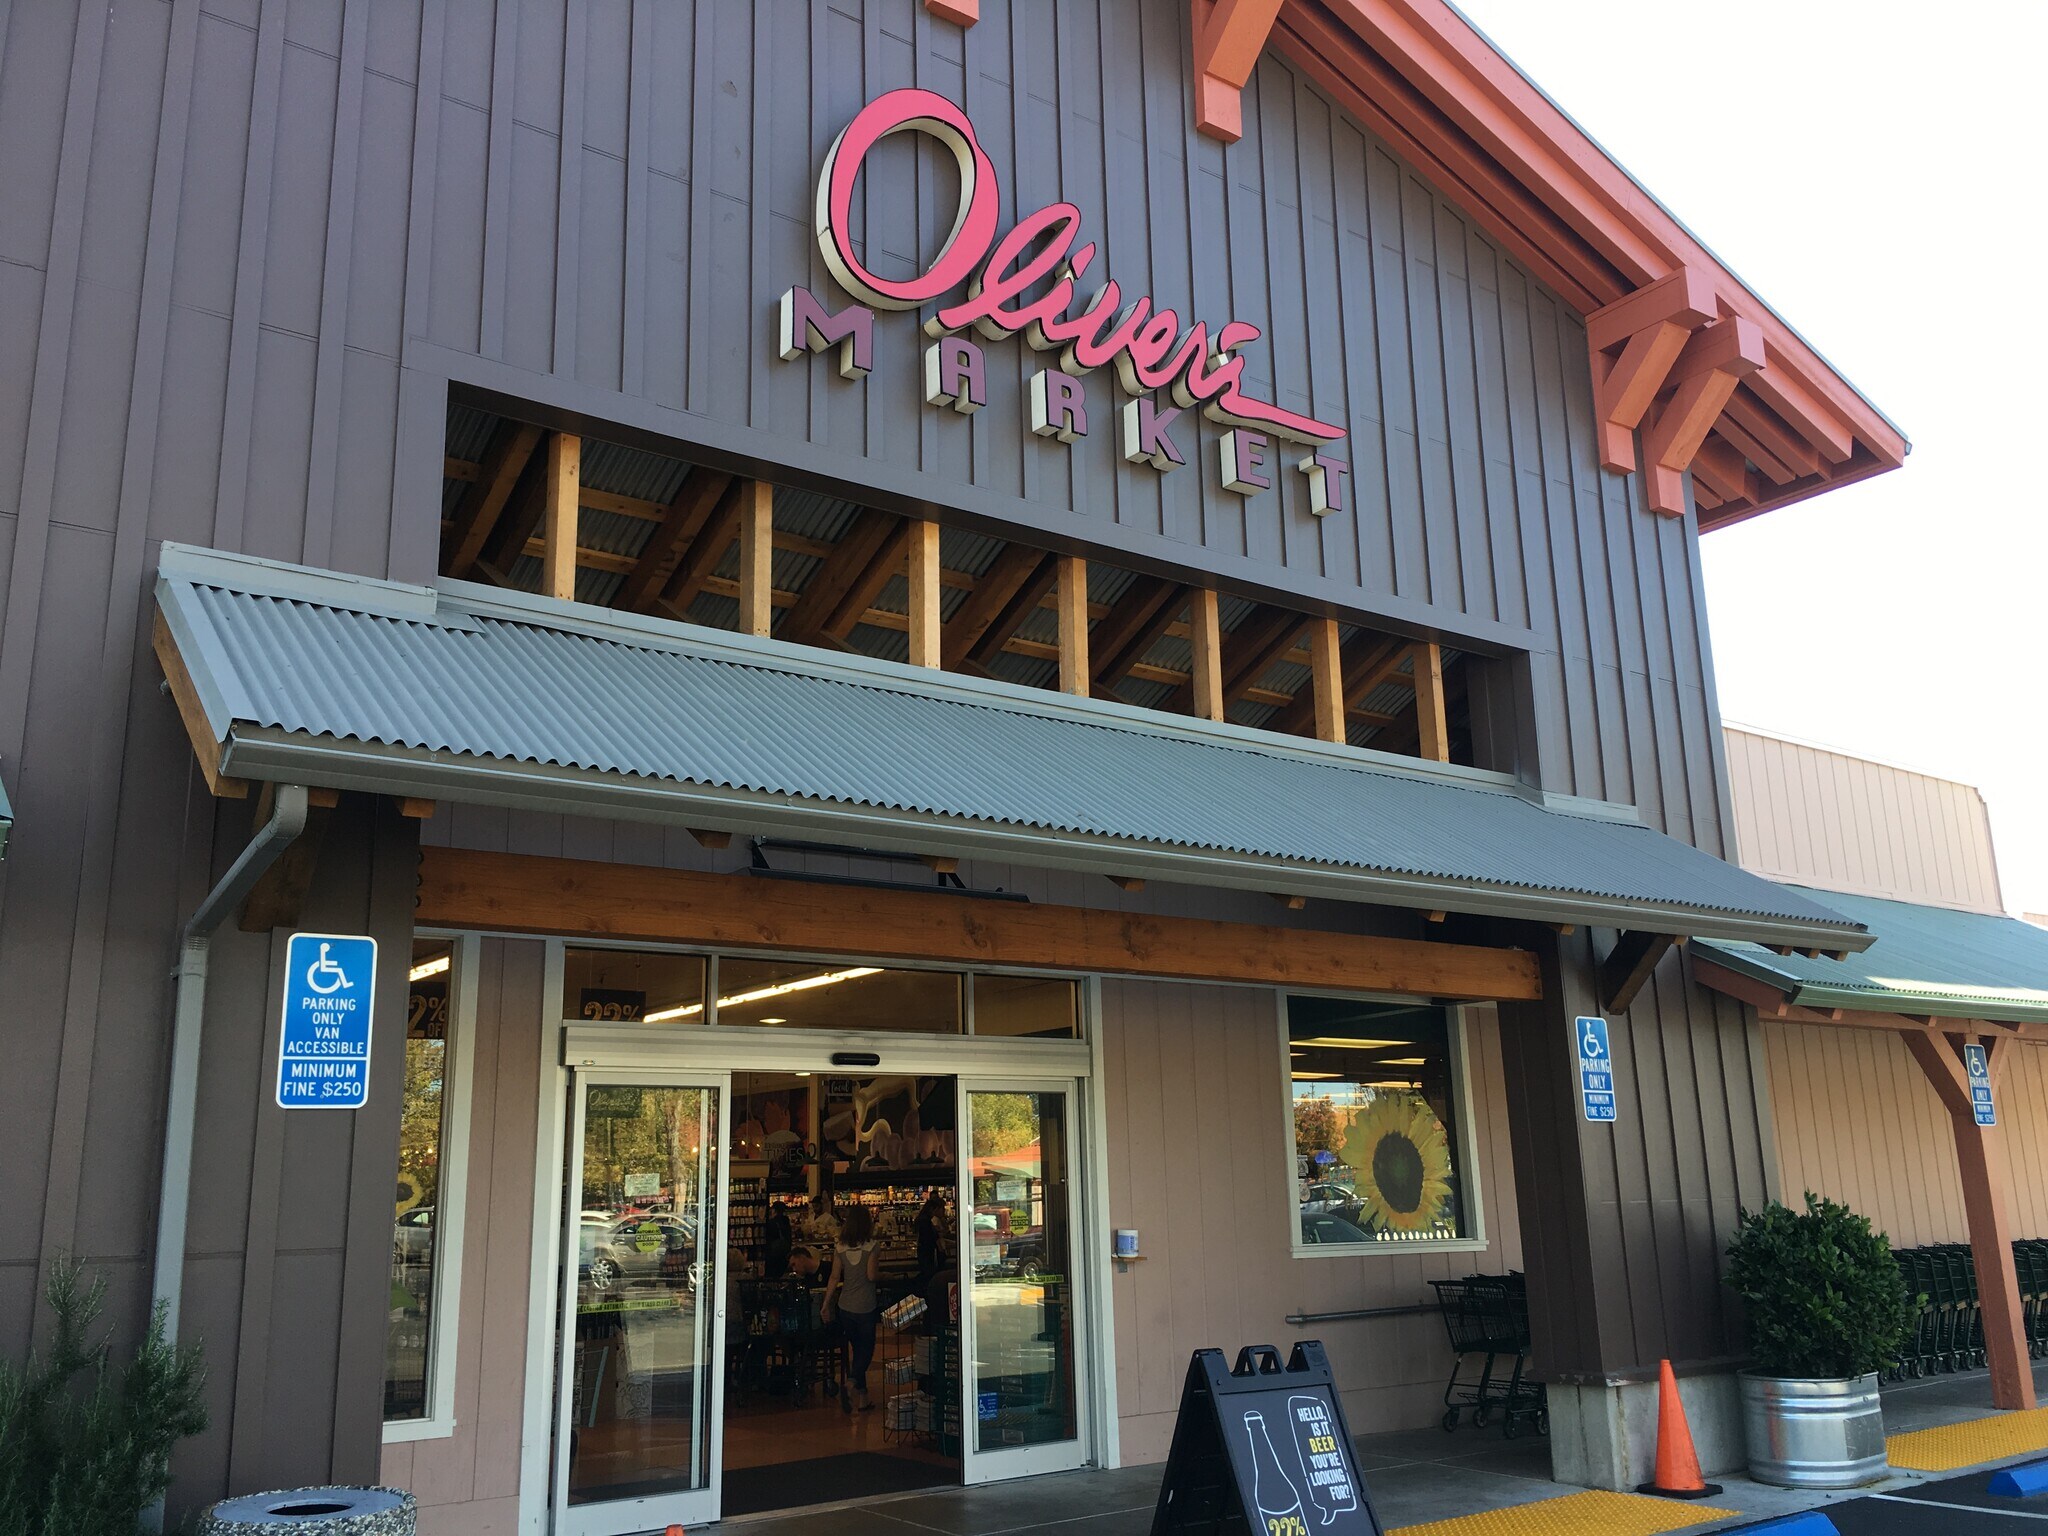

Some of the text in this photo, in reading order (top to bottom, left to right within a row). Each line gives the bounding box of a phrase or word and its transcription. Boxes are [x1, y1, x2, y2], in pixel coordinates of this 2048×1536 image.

[781, 285, 1347, 517] MARKET
[302, 997, 356, 1011] PARKING
[312, 1012, 345, 1025] ONLY
[315, 1027, 340, 1039] VAN
[287, 1041, 364, 1055] ACCESSIBLE
[291, 1063, 356, 1078] MINIMUM
[1581, 1058, 1610, 1074] PARKING
[283, 1081, 362, 1097] FINE $250
[1589, 1074, 1606, 1089] ONLY
[1297, 1406, 1327, 1422] HELLO,
[1311, 1421, 1330, 1437] IS IT
[1308, 1435, 1336, 1453] BEER
[1309, 1452, 1341, 1470] YOU'RE
[1309, 1468, 1346, 1487] LOOKING
[1328, 1484, 1351, 1501] FOR?
